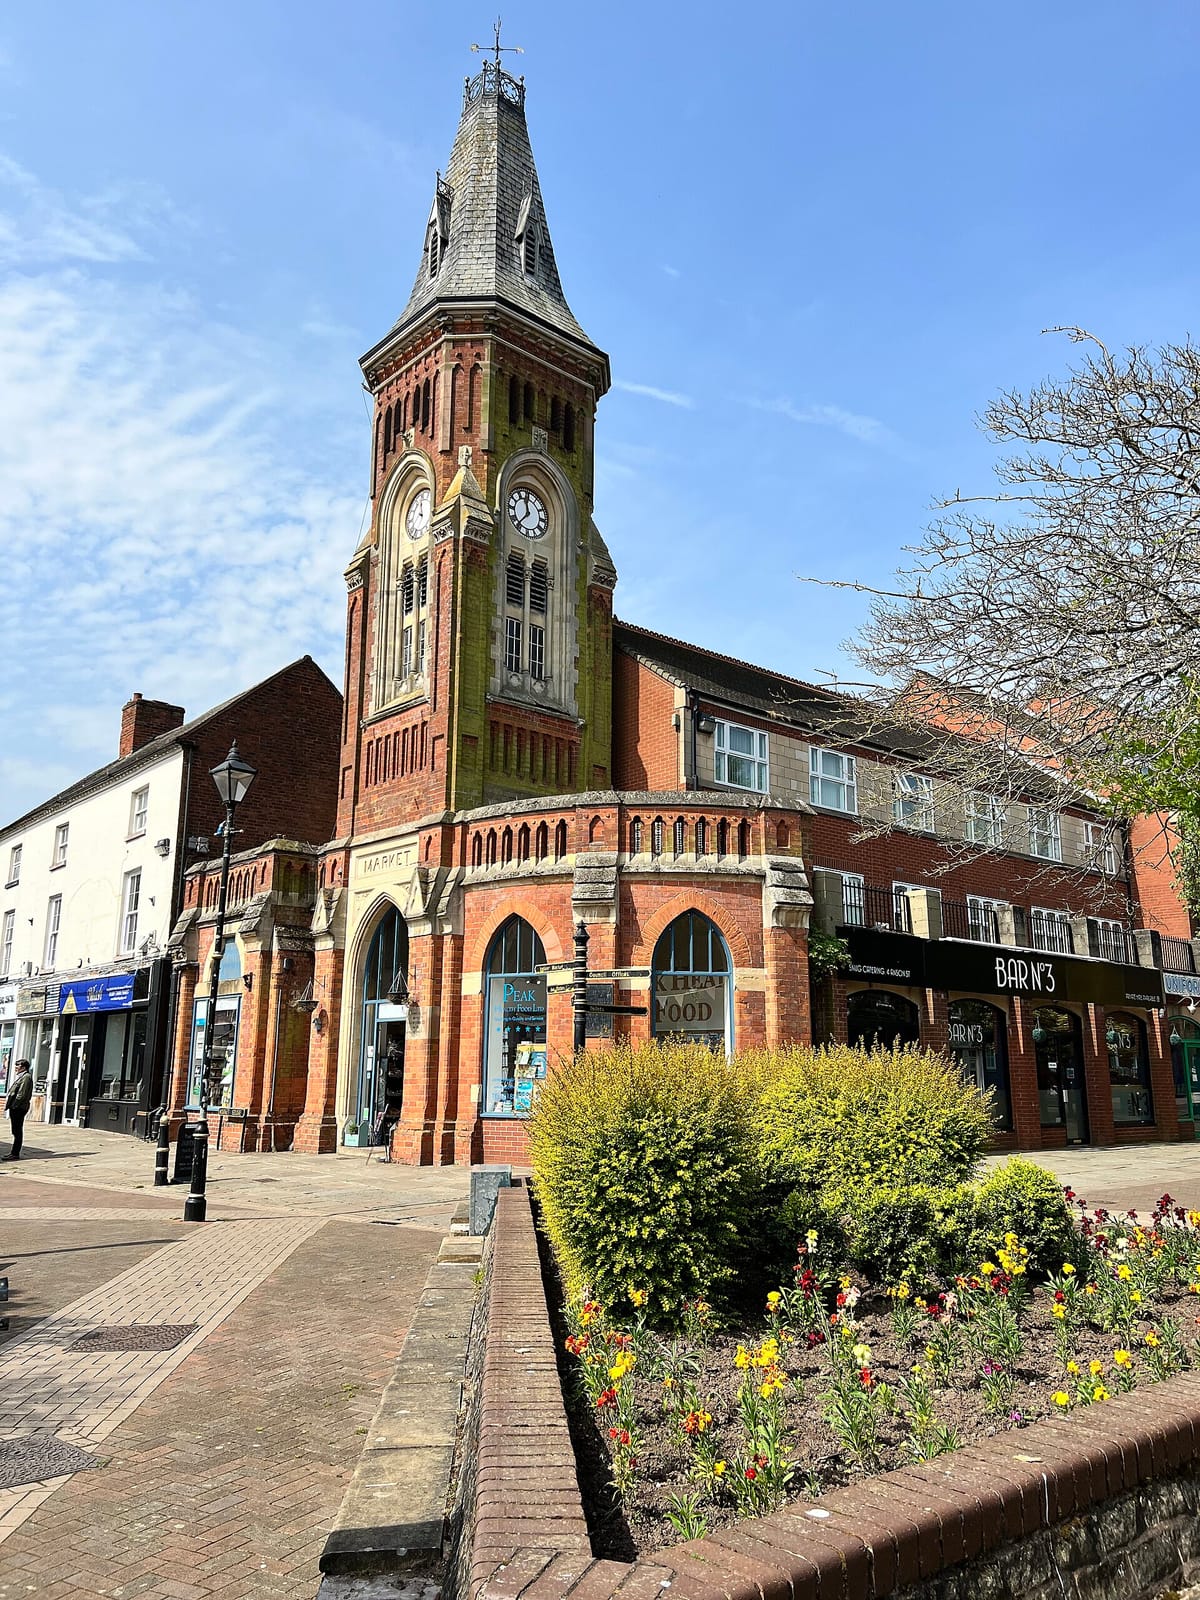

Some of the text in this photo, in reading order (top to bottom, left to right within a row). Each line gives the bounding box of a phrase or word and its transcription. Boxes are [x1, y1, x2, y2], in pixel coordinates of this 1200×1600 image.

[364, 850, 411, 873] MARKET
[995, 957, 1029, 990] BAR
[1165, 974, 1200, 995] UNIFOR
[503, 983, 536, 1003] PEAK
[656, 999, 712, 1023] FOOD
